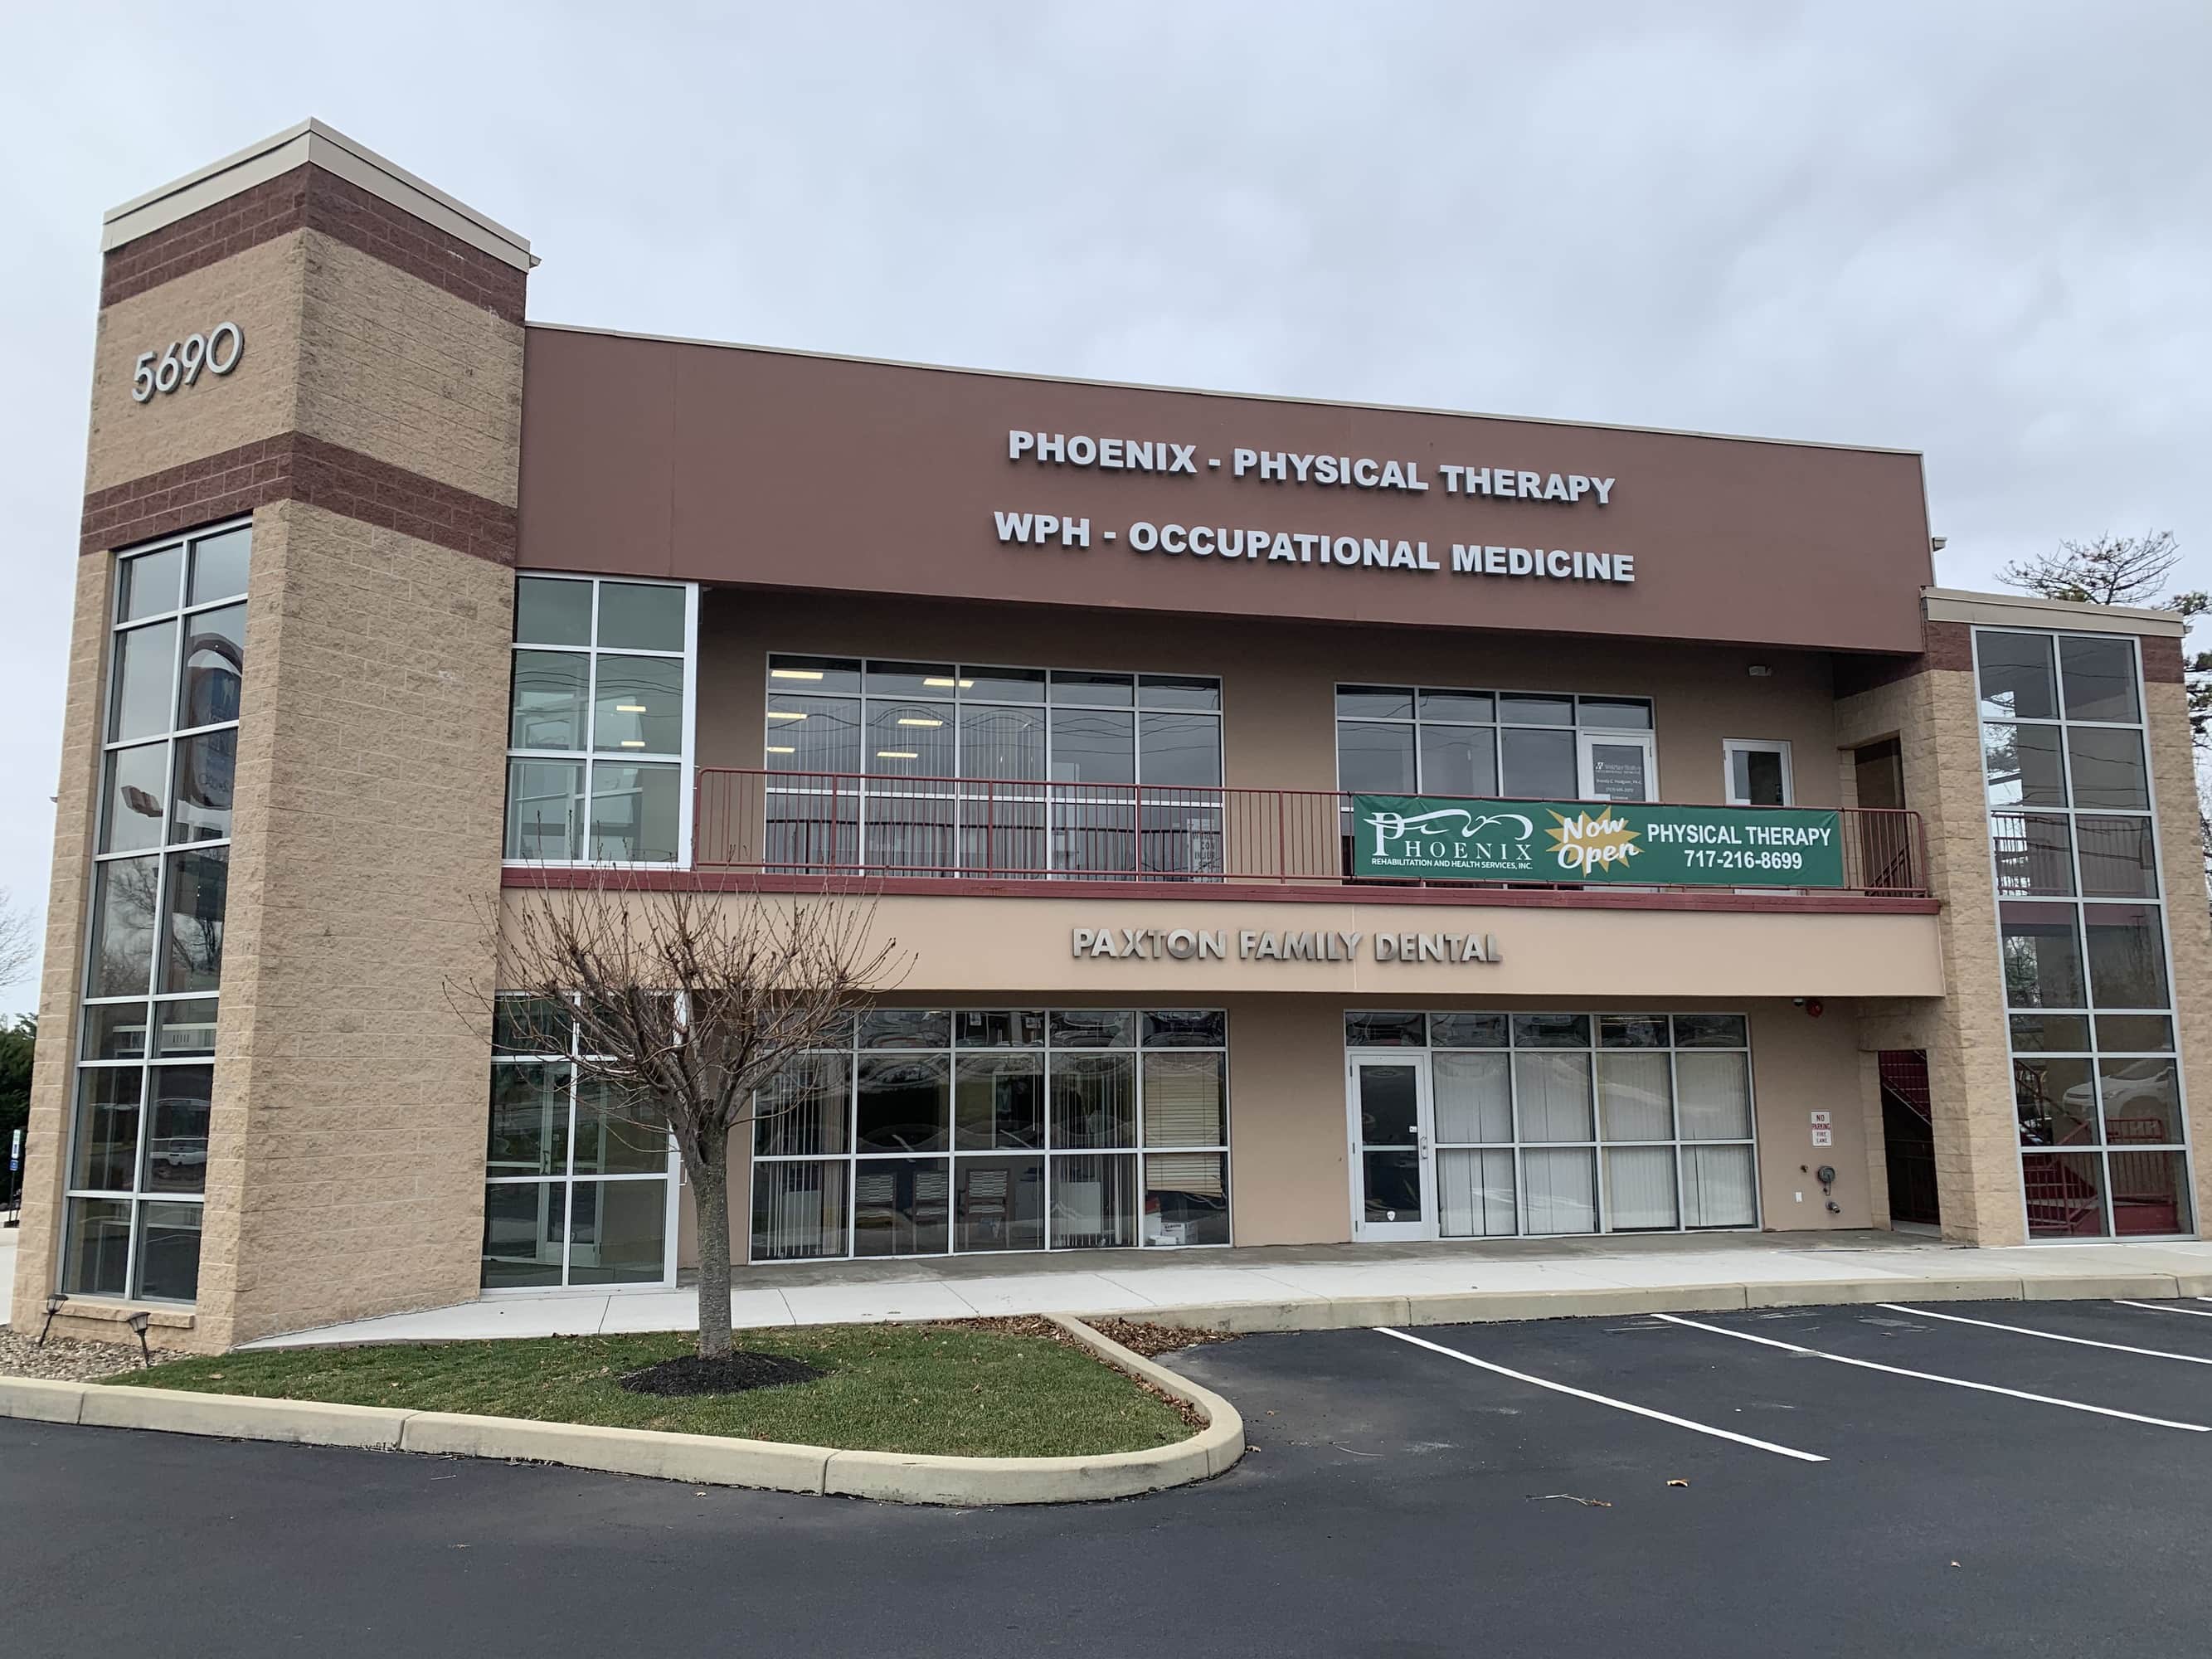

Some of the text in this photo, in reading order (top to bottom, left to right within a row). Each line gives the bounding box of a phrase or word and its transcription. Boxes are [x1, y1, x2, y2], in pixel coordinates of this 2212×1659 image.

[132, 321, 244, 402] 5690
[1009, 430, 1198, 474] PHOENIX
[1233, 447, 1429, 491] PHYSICAL
[1439, 465, 1616, 505] THERAPY
[994, 511, 1090, 547] WPH
[1129, 521, 1441, 571] OCCUPATIONAL
[1451, 543, 1636, 582] MEDICINE
[1563, 815, 1625, 844] Now
[1647, 824, 1832, 846] PHYSICAL THERAPY
[1371, 858, 1432, 867] REHABILITATION
[1451, 860, 1480, 868] HEALTH
[1480, 861, 1518, 870] SERVICES,
[1558, 843, 1640, 873] Open
[1684, 849, 1803, 869] 717-216-8699
[1072, 928, 1502, 963] PAXTON FAMILY DENTAL
